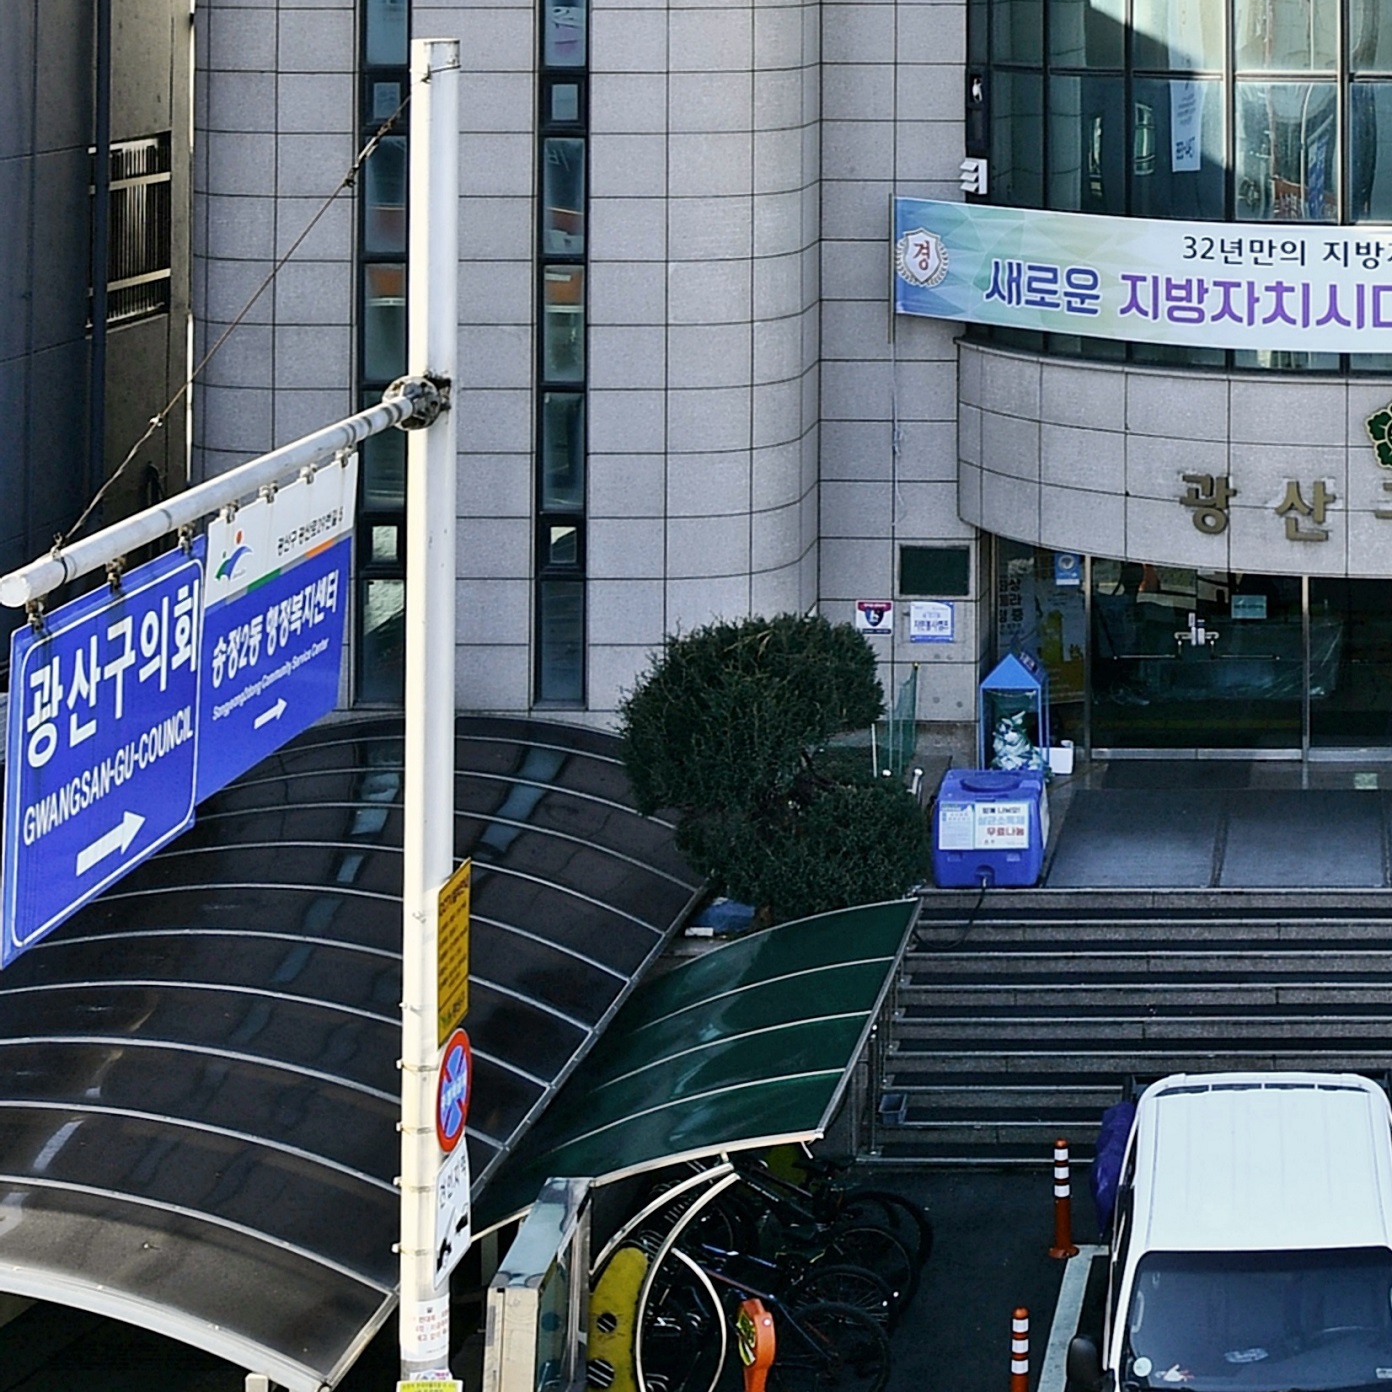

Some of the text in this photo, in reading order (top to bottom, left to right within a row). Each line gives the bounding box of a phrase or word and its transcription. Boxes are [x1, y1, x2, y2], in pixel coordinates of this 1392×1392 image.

[912, 241, 932, 270] 경
[1183, 236, 1305, 267] 32년만의
[984, 259, 1101, 315] 새로운
[212, 569, 339, 689] 송정2동 행정복지센터
[311, 637, 330, 657] Center
[26, 578, 200, 769] 광산구의회
[23, 705, 194, 847] GWANGSAN-GU-COUNCIL
